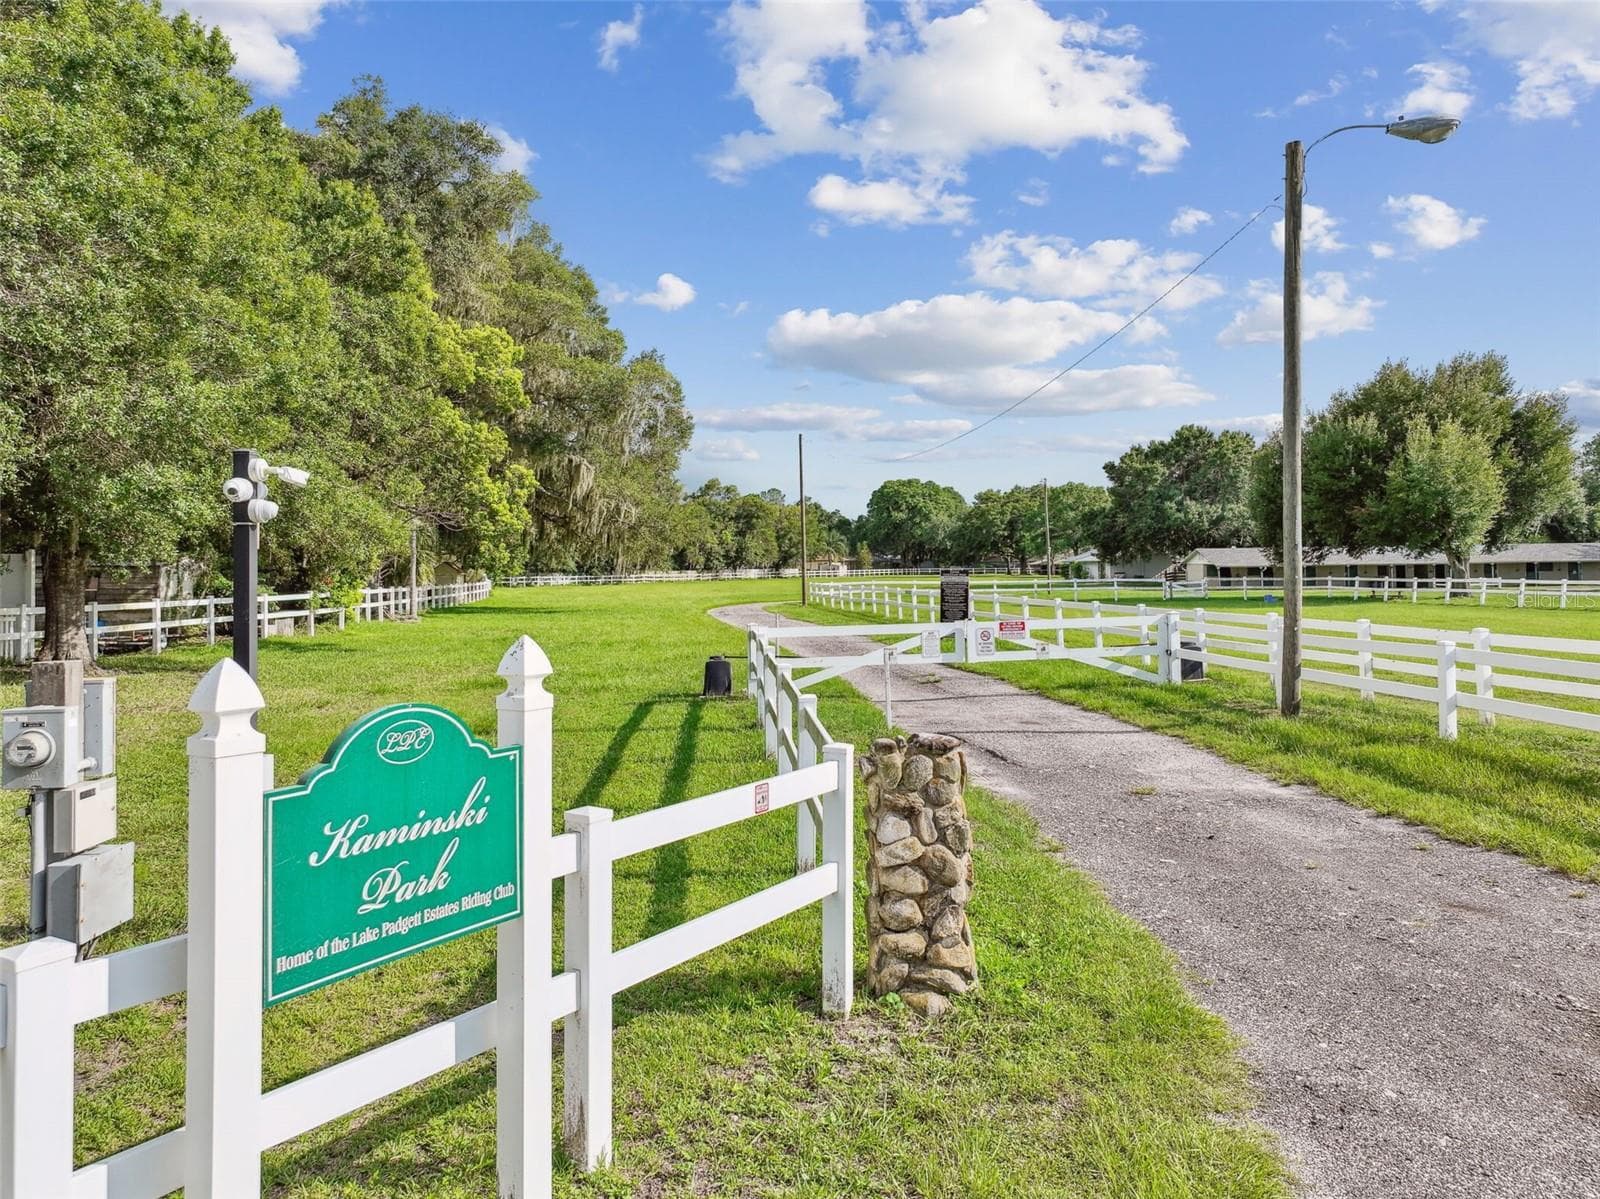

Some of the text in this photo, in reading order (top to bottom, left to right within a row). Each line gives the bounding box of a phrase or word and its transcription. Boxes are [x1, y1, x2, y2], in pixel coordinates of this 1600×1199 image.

[382, 727, 431, 753] LPE
[309, 776, 491, 867] Kaminski
[357, 836, 460, 915] Park
[276, 881, 515, 975] Home of the Lake Padgett Estates Riding Club
